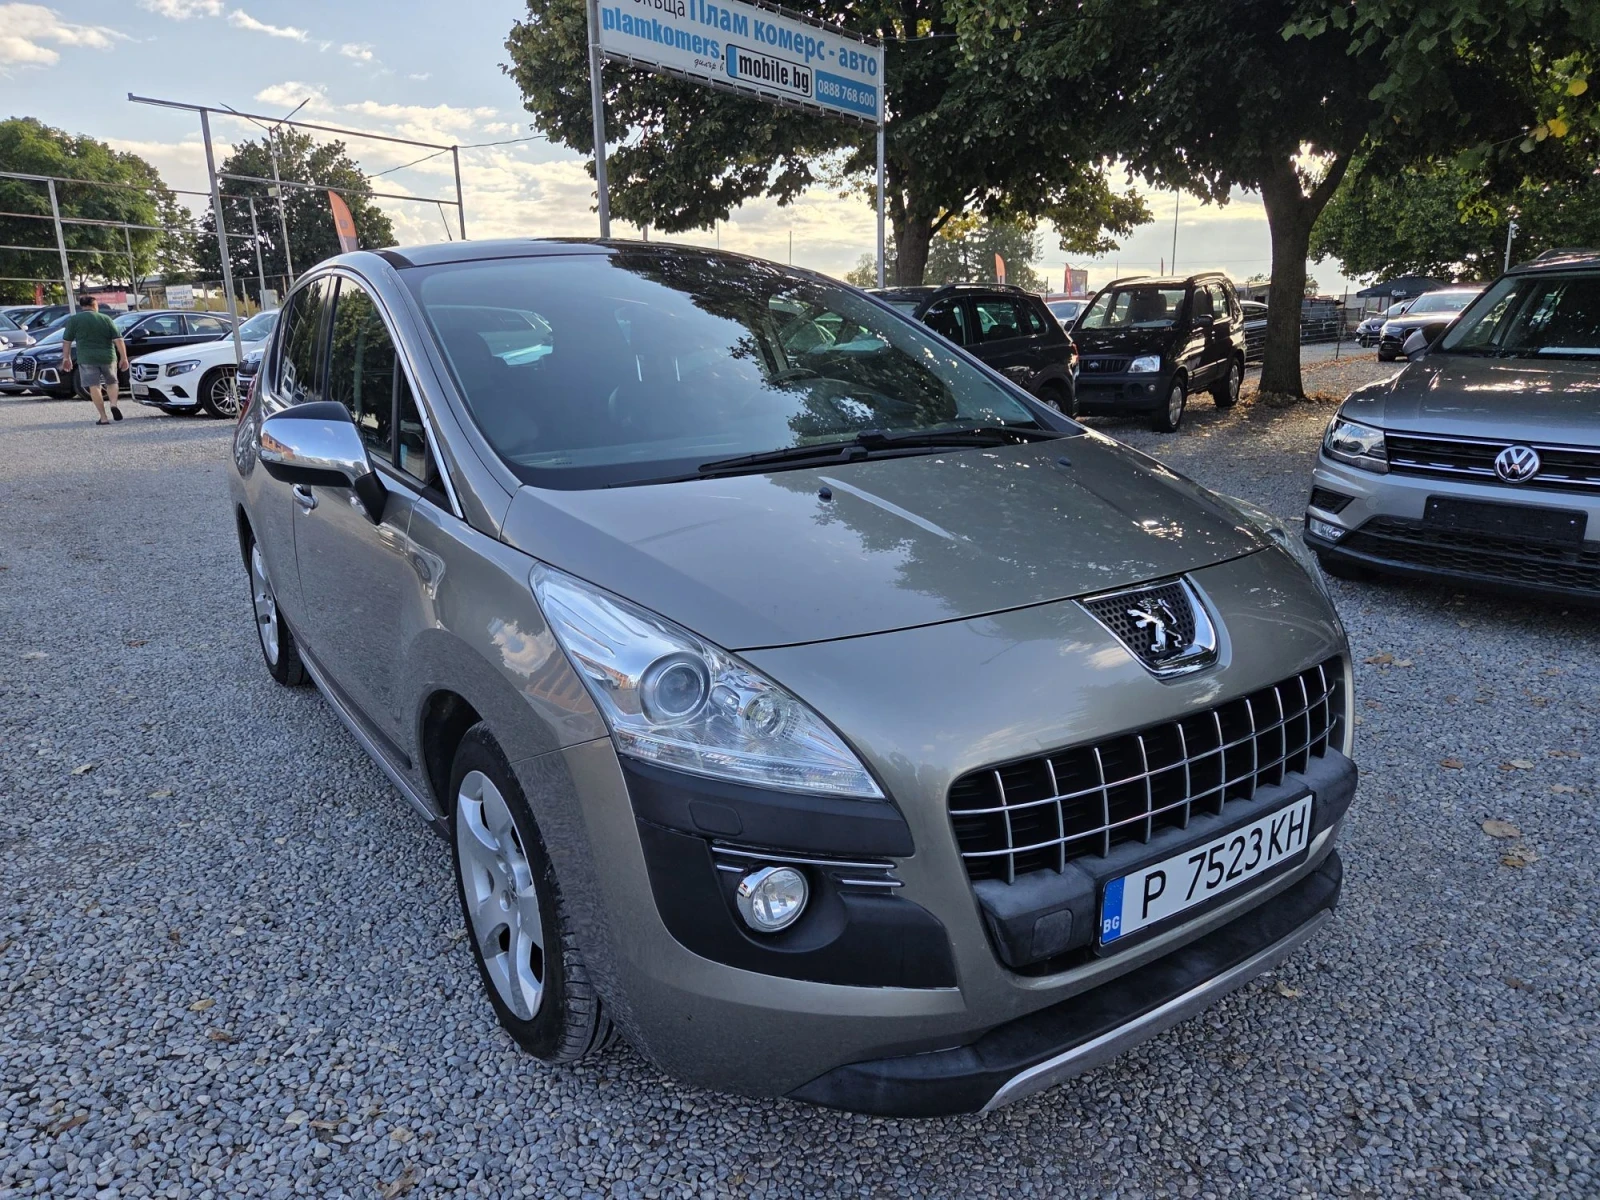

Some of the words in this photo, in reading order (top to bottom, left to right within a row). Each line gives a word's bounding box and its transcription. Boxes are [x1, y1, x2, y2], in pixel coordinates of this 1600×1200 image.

[690, 0, 748, 37] Плам
[754, 20, 825, 63] комерс
[839, 47, 877, 76] авто
[739, 54, 809, 93] mobile.bg
[818, 79, 840, 97] 0888
[841, 86, 858, 103] 768
[859, 90, 875, 107] 600
[1142, 870, 1166, 919] P
[1185, 828, 1263, 901] 7523
[1267, 804, 1306, 861] KH
[1103, 916, 1120, 934] BG
